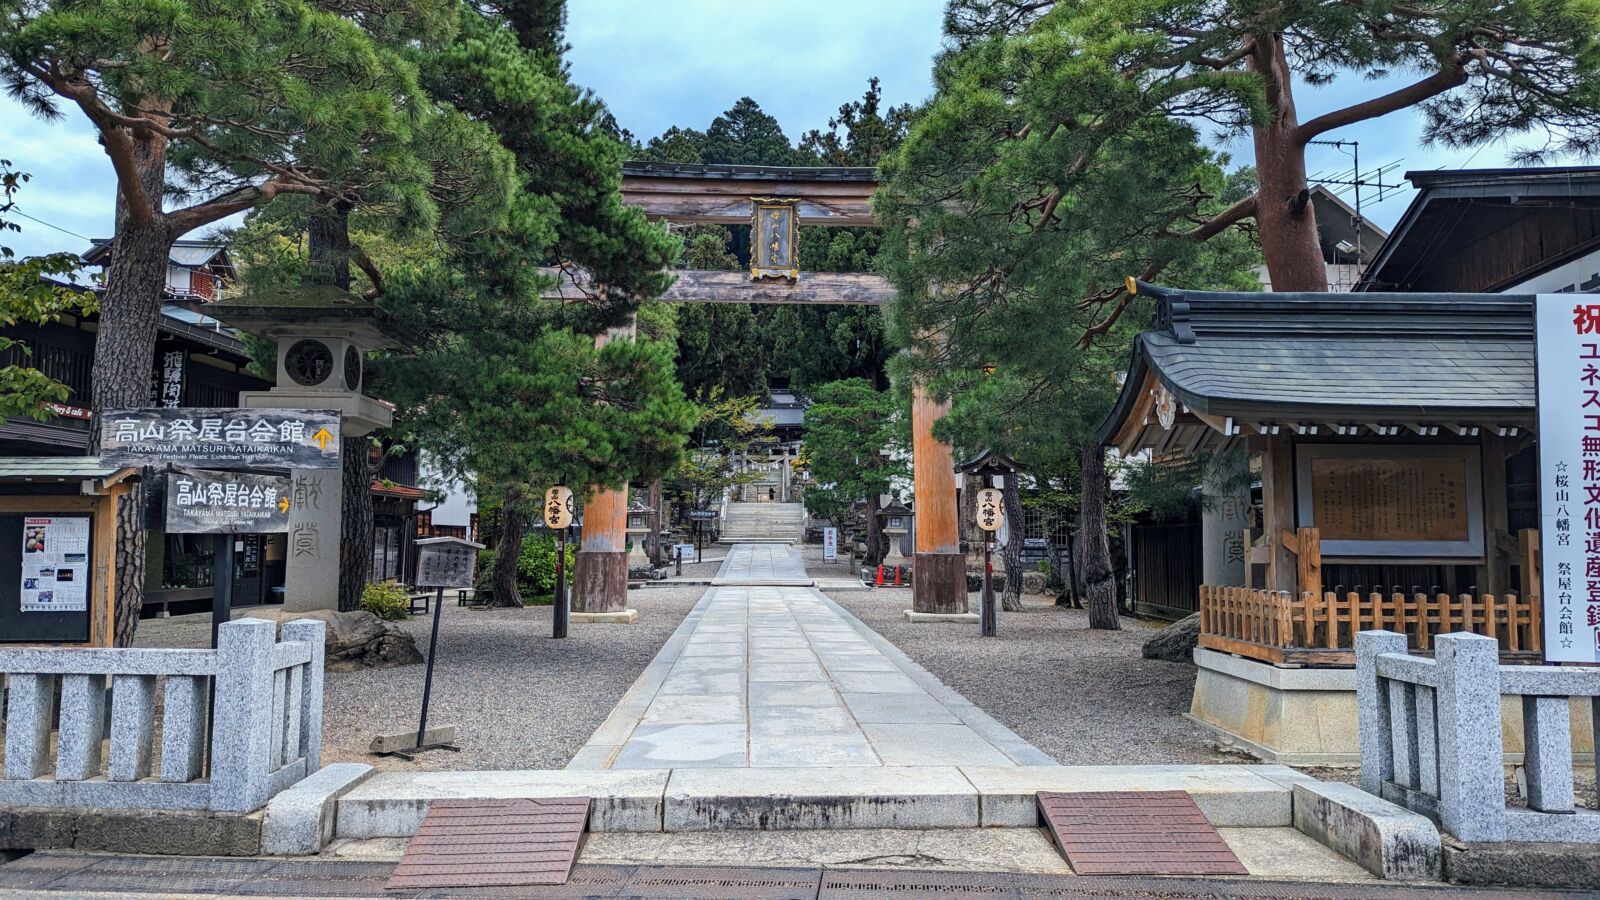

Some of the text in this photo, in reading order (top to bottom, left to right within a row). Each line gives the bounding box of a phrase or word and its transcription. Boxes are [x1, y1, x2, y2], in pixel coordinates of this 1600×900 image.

[1573, 304, 1600, 335] 祝
[115, 419, 305, 443] 高山祭屋台会館
[127, 445, 294, 453] TAKAYAMA MATSURI YATAIKAIKAN
[176, 478, 278, 508] 高山祭屋台会館
[183, 508, 214, 517] TAKAYAMA
[215, 510, 239, 518] MATSURI
[1555, 474, 1573, 634] 桜山八幡宮 祭屋台会館
